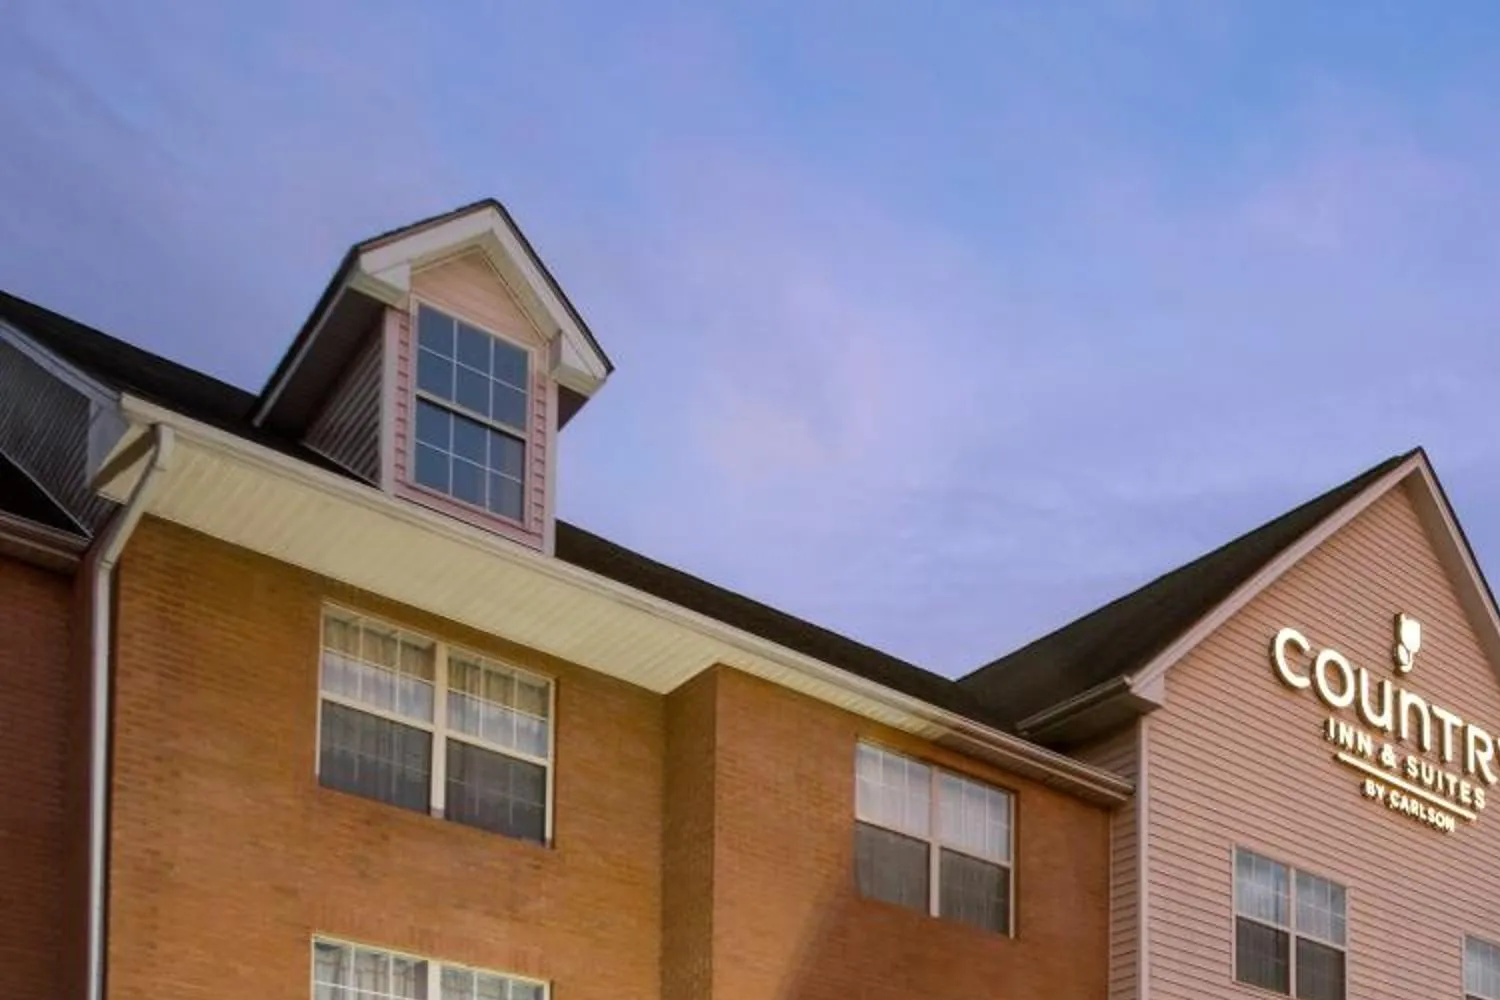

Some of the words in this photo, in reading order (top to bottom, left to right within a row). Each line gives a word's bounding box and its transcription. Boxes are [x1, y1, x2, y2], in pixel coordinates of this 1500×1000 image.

[1327, 715, 1373, 758] INN
[1380, 743, 1397, 769] &
[1406, 755, 1487, 811] SUITES
[1364, 778, 1386, 801] BY
[1389, 789, 1456, 833] CARLSON
